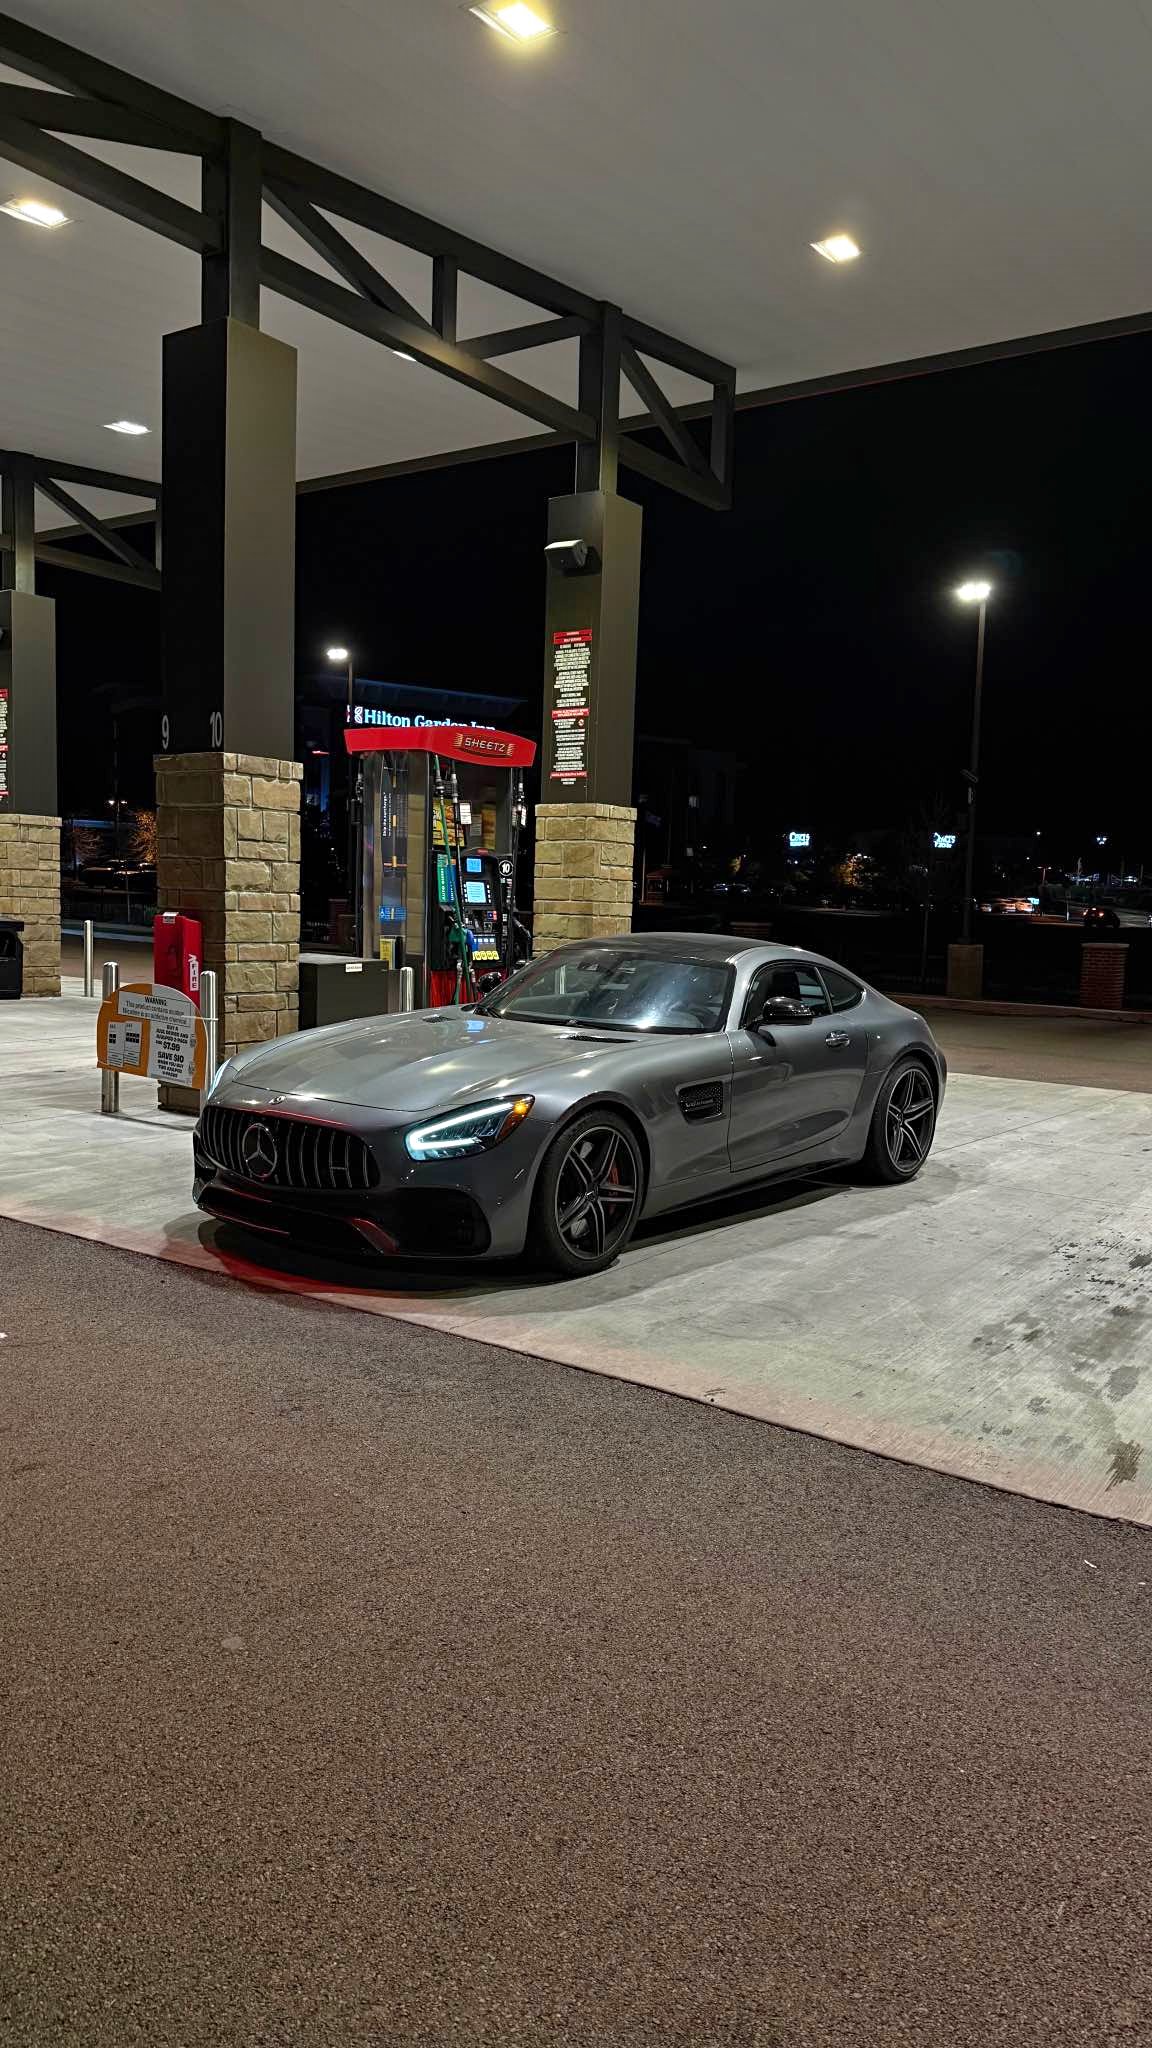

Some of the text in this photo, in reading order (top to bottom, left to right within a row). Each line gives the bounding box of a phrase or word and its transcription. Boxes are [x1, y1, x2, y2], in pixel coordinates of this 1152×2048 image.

[364, 708, 410, 727] Hilton
[162, 714, 169, 749] 9
[209, 711, 222, 748] 10
[464, 737, 506, 752] SHEETZ
[501, 864, 511, 873] 10
[163, 1041, 181, 1051] $7.99
[157, 1051, 185, 1063] SAVE $10
